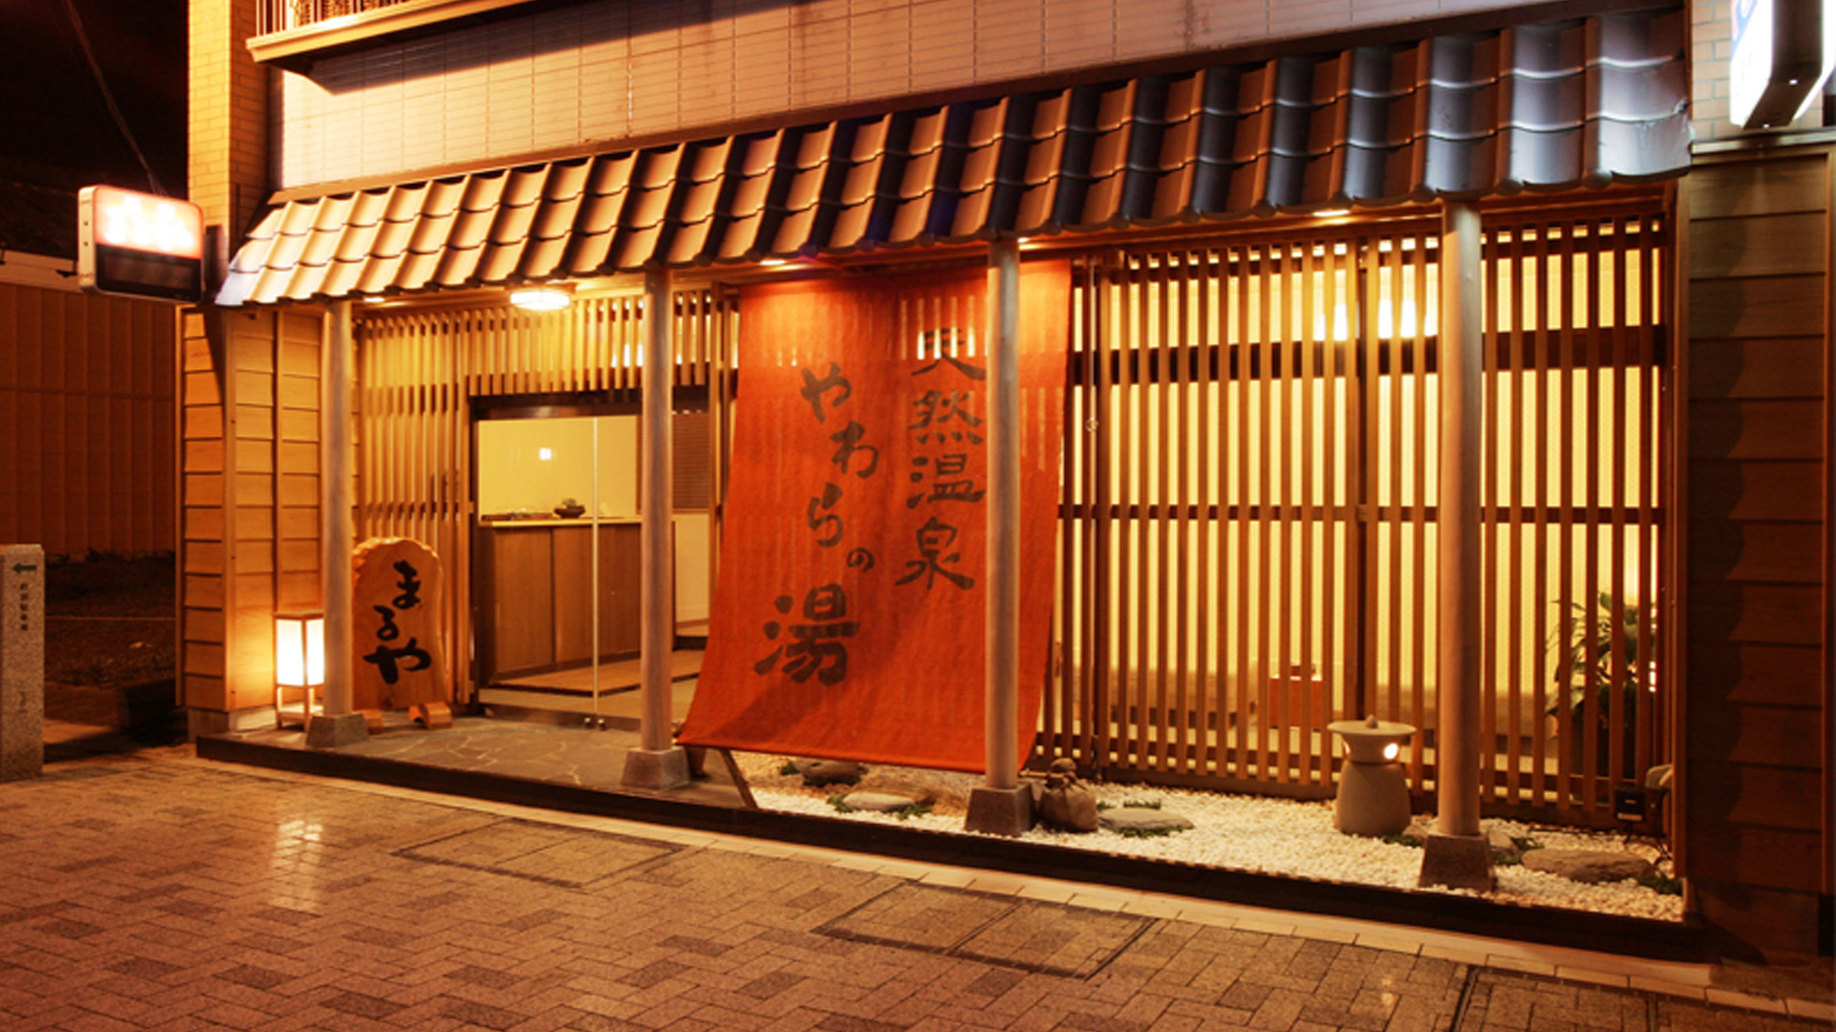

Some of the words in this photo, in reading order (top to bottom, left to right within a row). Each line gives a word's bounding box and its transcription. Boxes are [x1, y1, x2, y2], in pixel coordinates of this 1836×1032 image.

[754, 361, 881, 687] やわらの湯
[895, 328, 987, 591] 天然温泉
[363, 560, 432, 685] まるや
